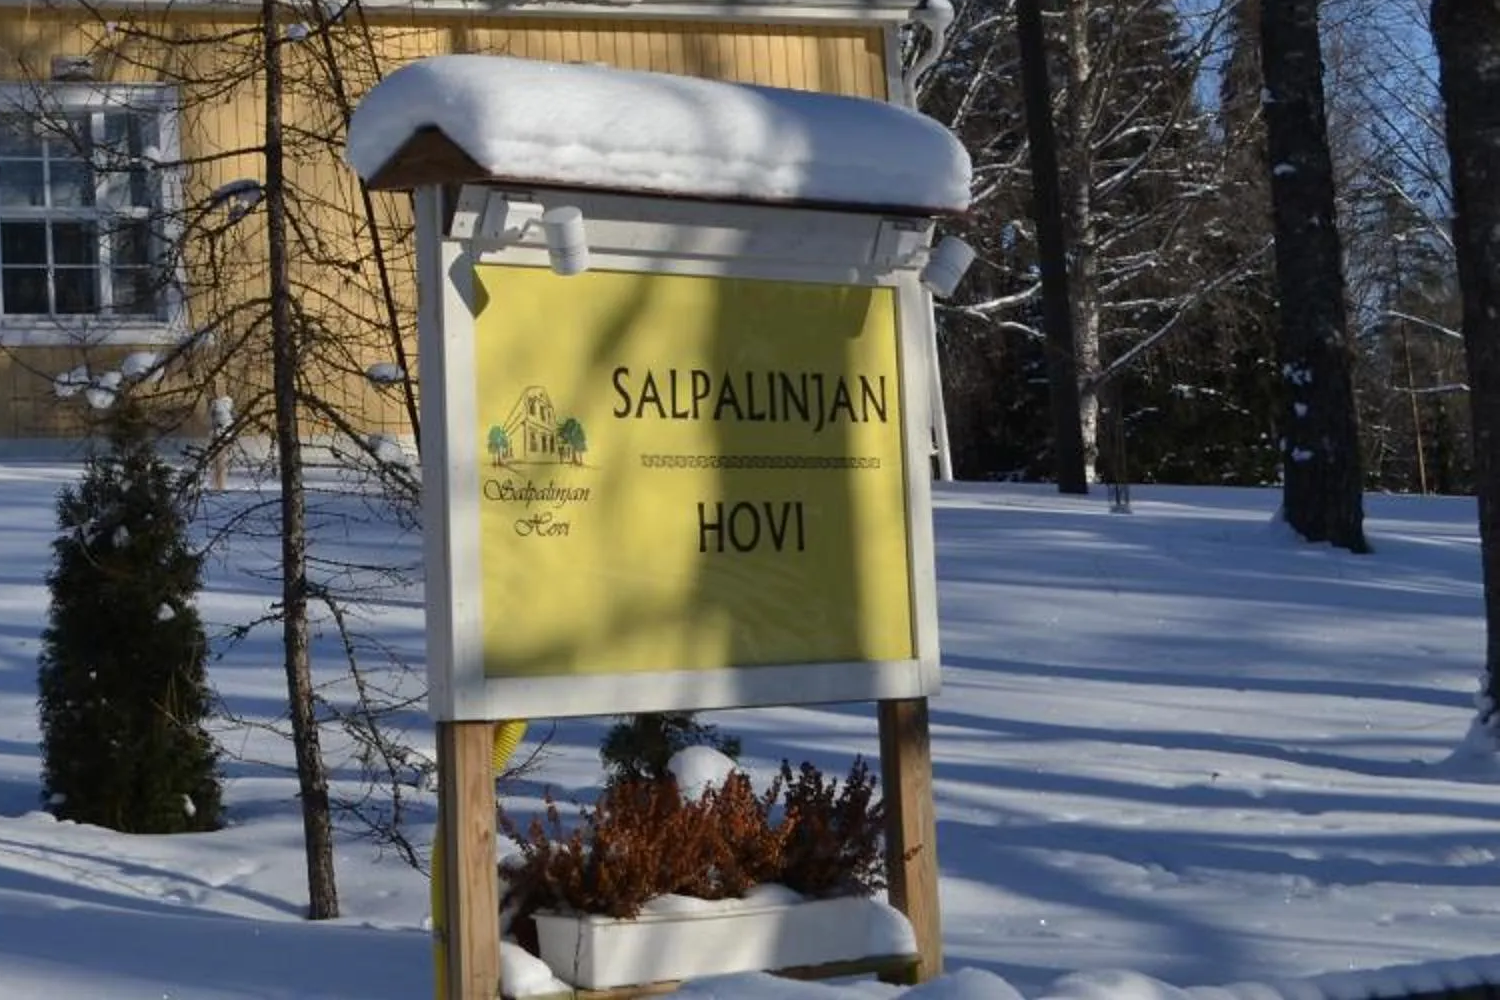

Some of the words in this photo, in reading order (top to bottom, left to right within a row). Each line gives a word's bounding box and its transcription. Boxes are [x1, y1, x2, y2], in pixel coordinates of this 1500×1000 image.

[612, 367, 887, 432] SALPALINJAN
[483, 479, 590, 508] Salpalinjan
[514, 511, 570, 537] Hovi
[697, 501, 805, 552] HOVI
